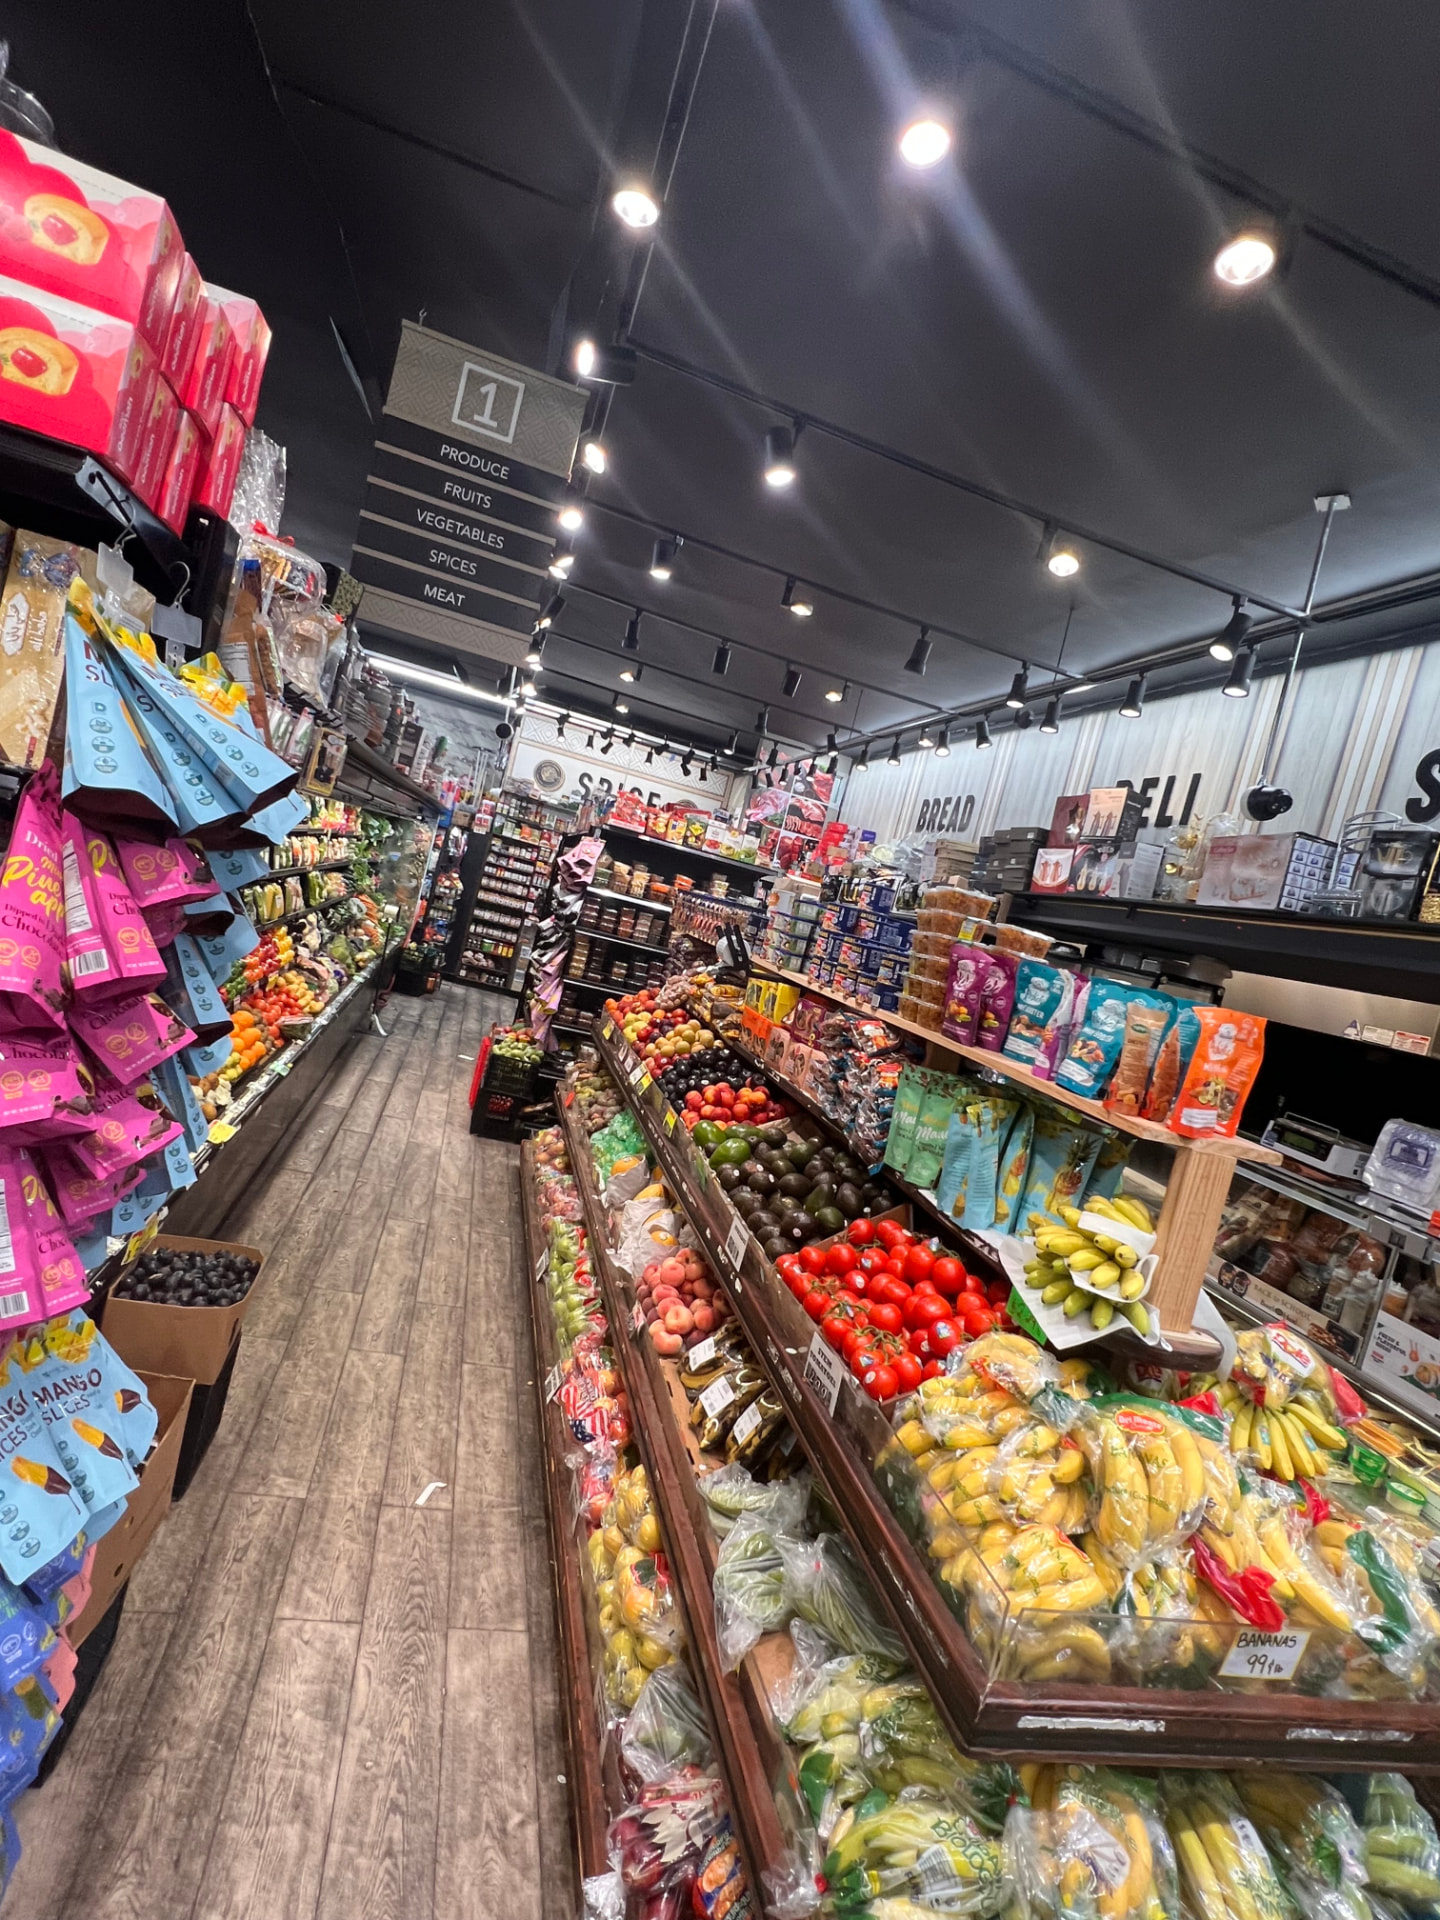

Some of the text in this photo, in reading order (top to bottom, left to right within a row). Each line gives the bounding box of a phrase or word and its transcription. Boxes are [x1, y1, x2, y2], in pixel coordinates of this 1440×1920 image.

[472, 381, 498, 428] 1
[440, 444, 510, 480] PRODUCE
[443, 482, 492, 509] FRUITS
[416, 508, 505, 549] VEGETABLES
[429, 549, 477, 576] SPICES
[423, 584, 466, 608] MEAT
[914, 794, 976, 833] BREAD
[31, 1368, 102, 1410] MANGO
[1236, 1632, 1297, 1649] BANANAS
